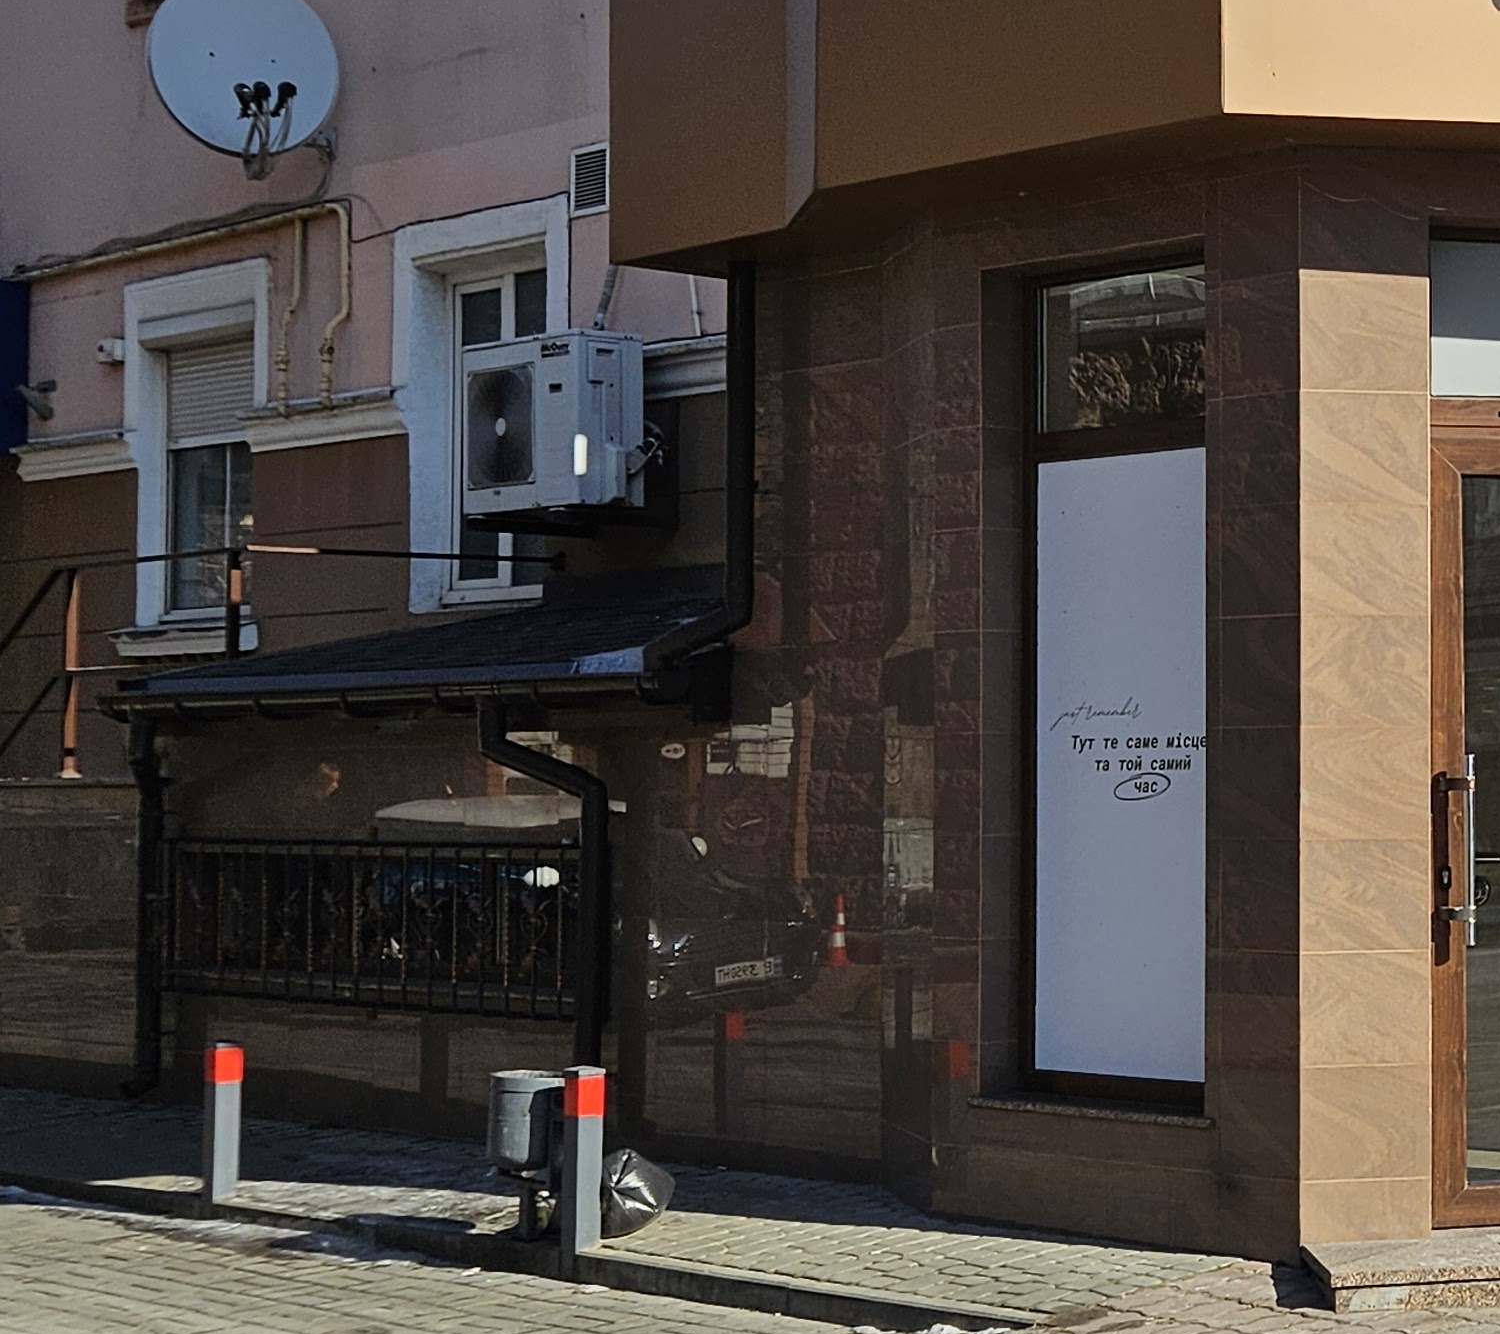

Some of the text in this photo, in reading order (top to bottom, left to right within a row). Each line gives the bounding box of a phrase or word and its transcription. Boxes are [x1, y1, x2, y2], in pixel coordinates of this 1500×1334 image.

[1086, 696, 1143, 720] remember
[1072, 735, 1095, 754] Тут
[1103, 737, 1118, 749] те
[1126, 736, 1158, 749] саме
[1095, 754, 1191, 771] та той самий
[1134, 781, 1158, 793] час
